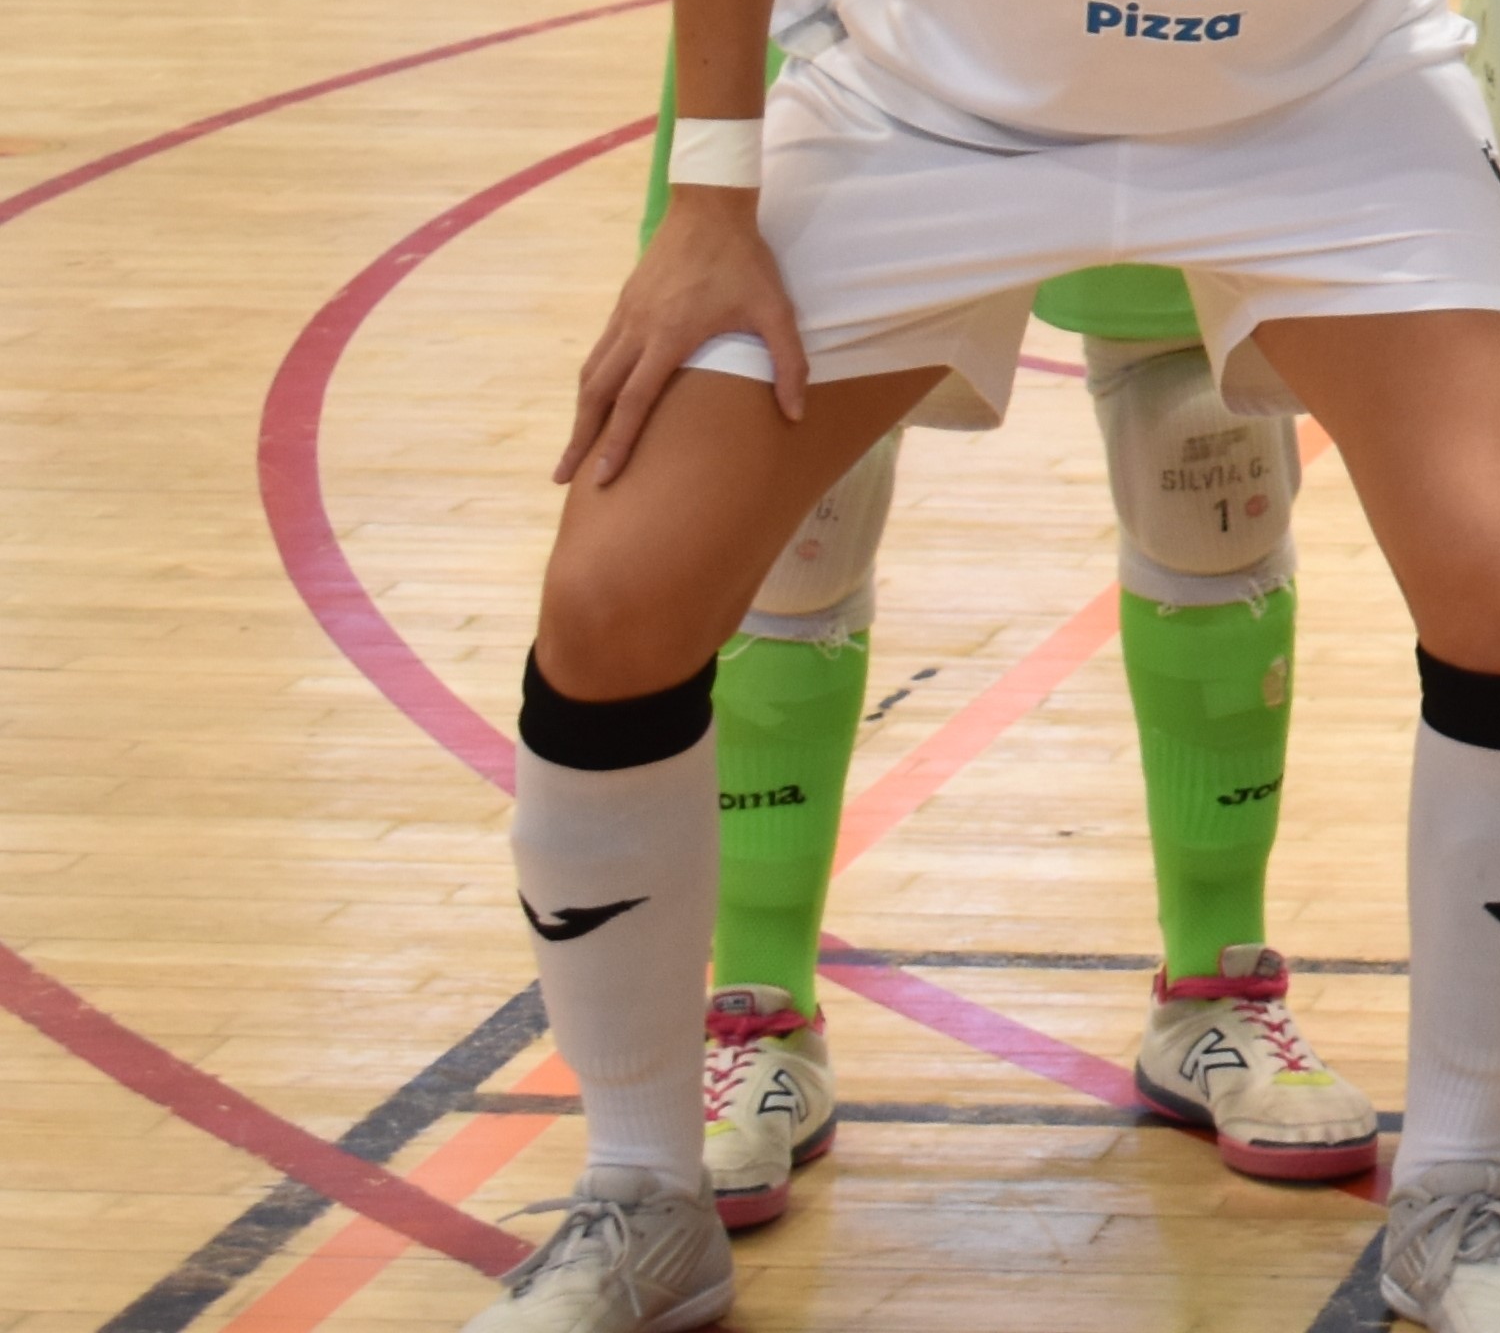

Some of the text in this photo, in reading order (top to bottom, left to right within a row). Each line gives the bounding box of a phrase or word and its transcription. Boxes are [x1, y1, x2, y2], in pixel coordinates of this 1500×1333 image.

[1086, 0, 1242, 42] Pizza
[1160, 463, 1241, 492] SILVIA
[1214, 499, 1228, 533] 1
[719, 783, 806, 811] oma
